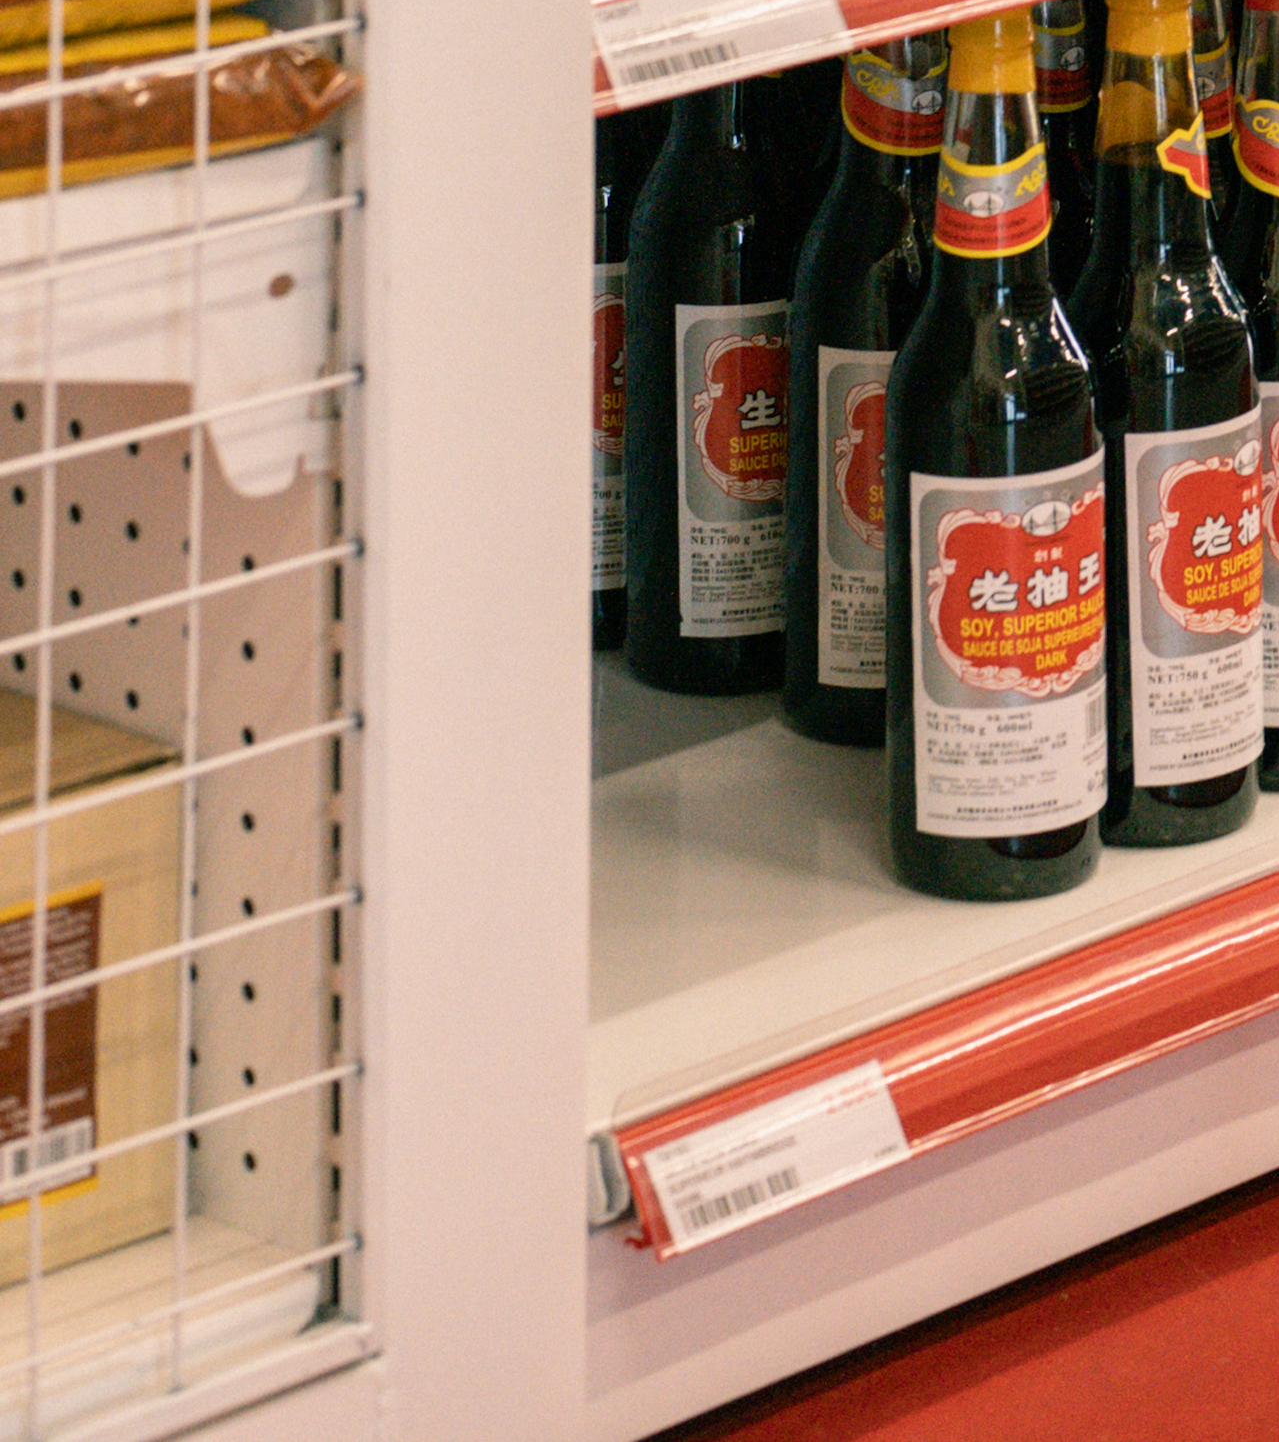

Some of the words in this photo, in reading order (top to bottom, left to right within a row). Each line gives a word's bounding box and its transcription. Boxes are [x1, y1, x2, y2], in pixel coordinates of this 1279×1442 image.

[1184, 565, 1216, 585] SOY,
[1186, 587, 1219, 605] SAUCE
[960, 619, 996, 637] SOY,
[1003, 607, 1074, 636] SUPERIOR
[962, 639, 1000, 658] SAUCE
[1036, 648, 1068, 671] DARK
